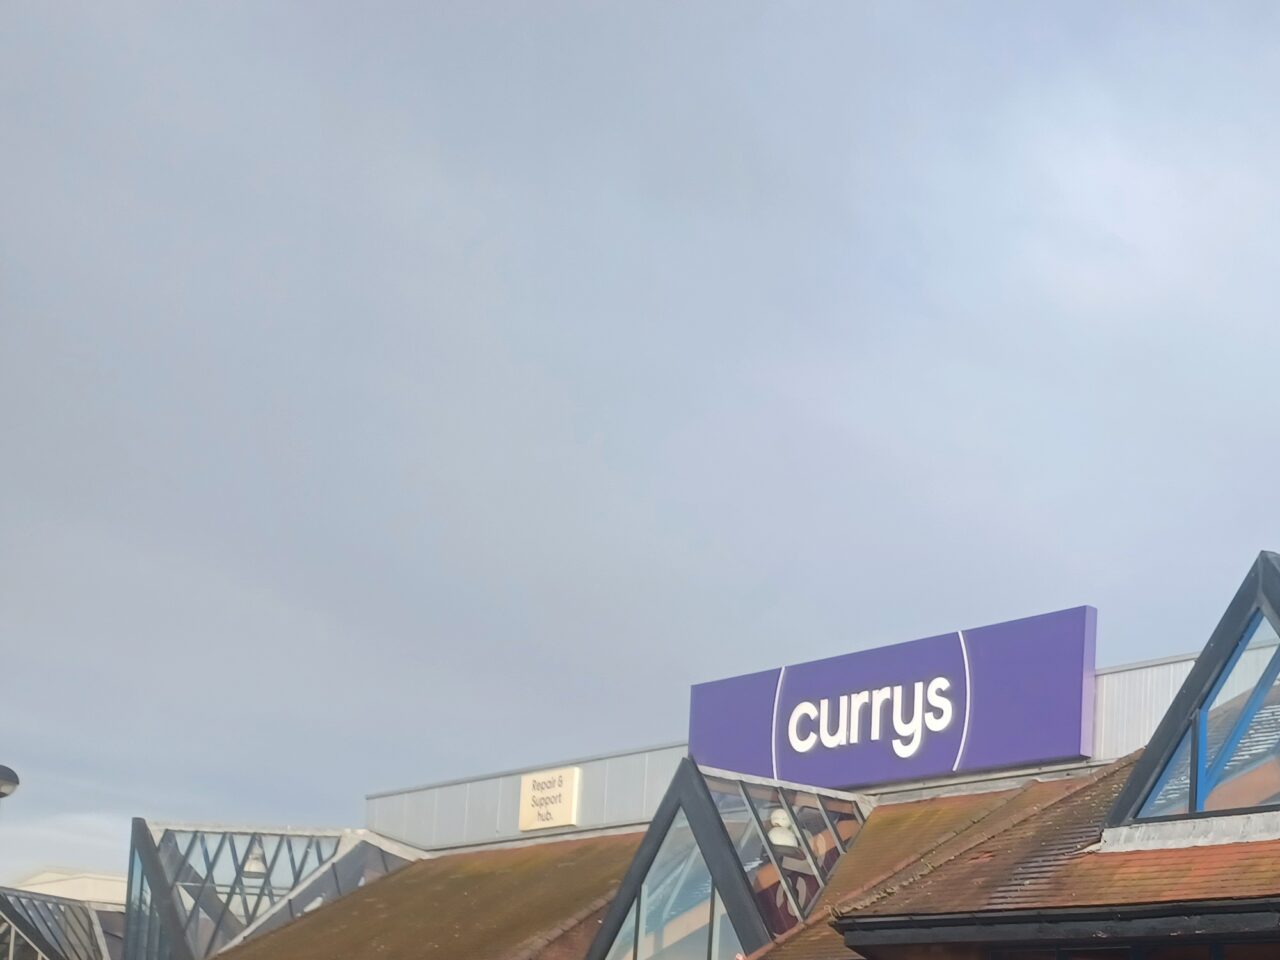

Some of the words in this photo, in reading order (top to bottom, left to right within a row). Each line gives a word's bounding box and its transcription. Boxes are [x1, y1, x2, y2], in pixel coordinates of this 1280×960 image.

[788, 676, 953, 758] currys
[532, 777, 556, 792] Repair
[531, 793, 562, 808] Support
